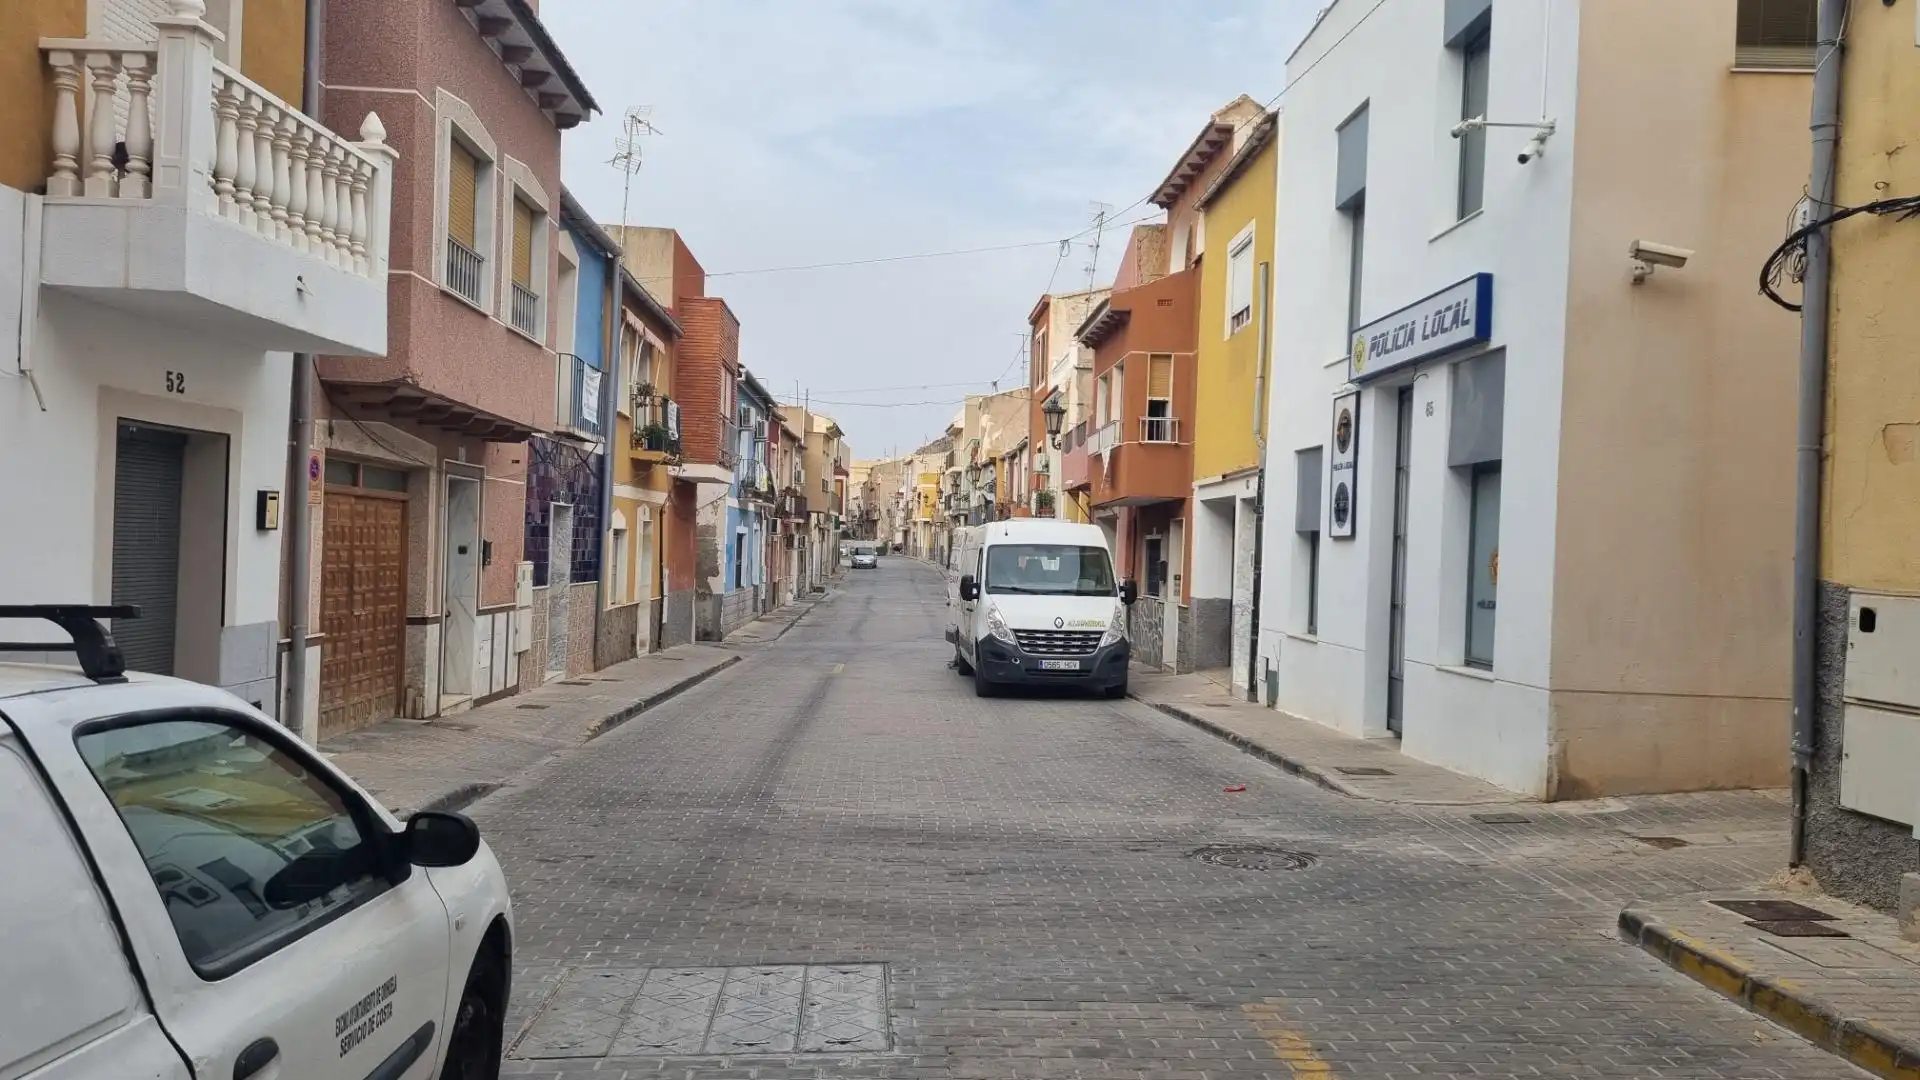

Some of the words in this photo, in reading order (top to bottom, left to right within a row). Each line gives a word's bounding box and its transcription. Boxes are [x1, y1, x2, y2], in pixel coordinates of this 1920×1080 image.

[1368, 320, 1416, 361] POLICIA
[1421, 298, 1471, 341] LOCAL
[166, 370, 185, 394] 52
[340, 1021, 367, 1059] SERVICIO
[367, 1013, 375, 1036] DE
[376, 1000, 393, 1029] COSTA
